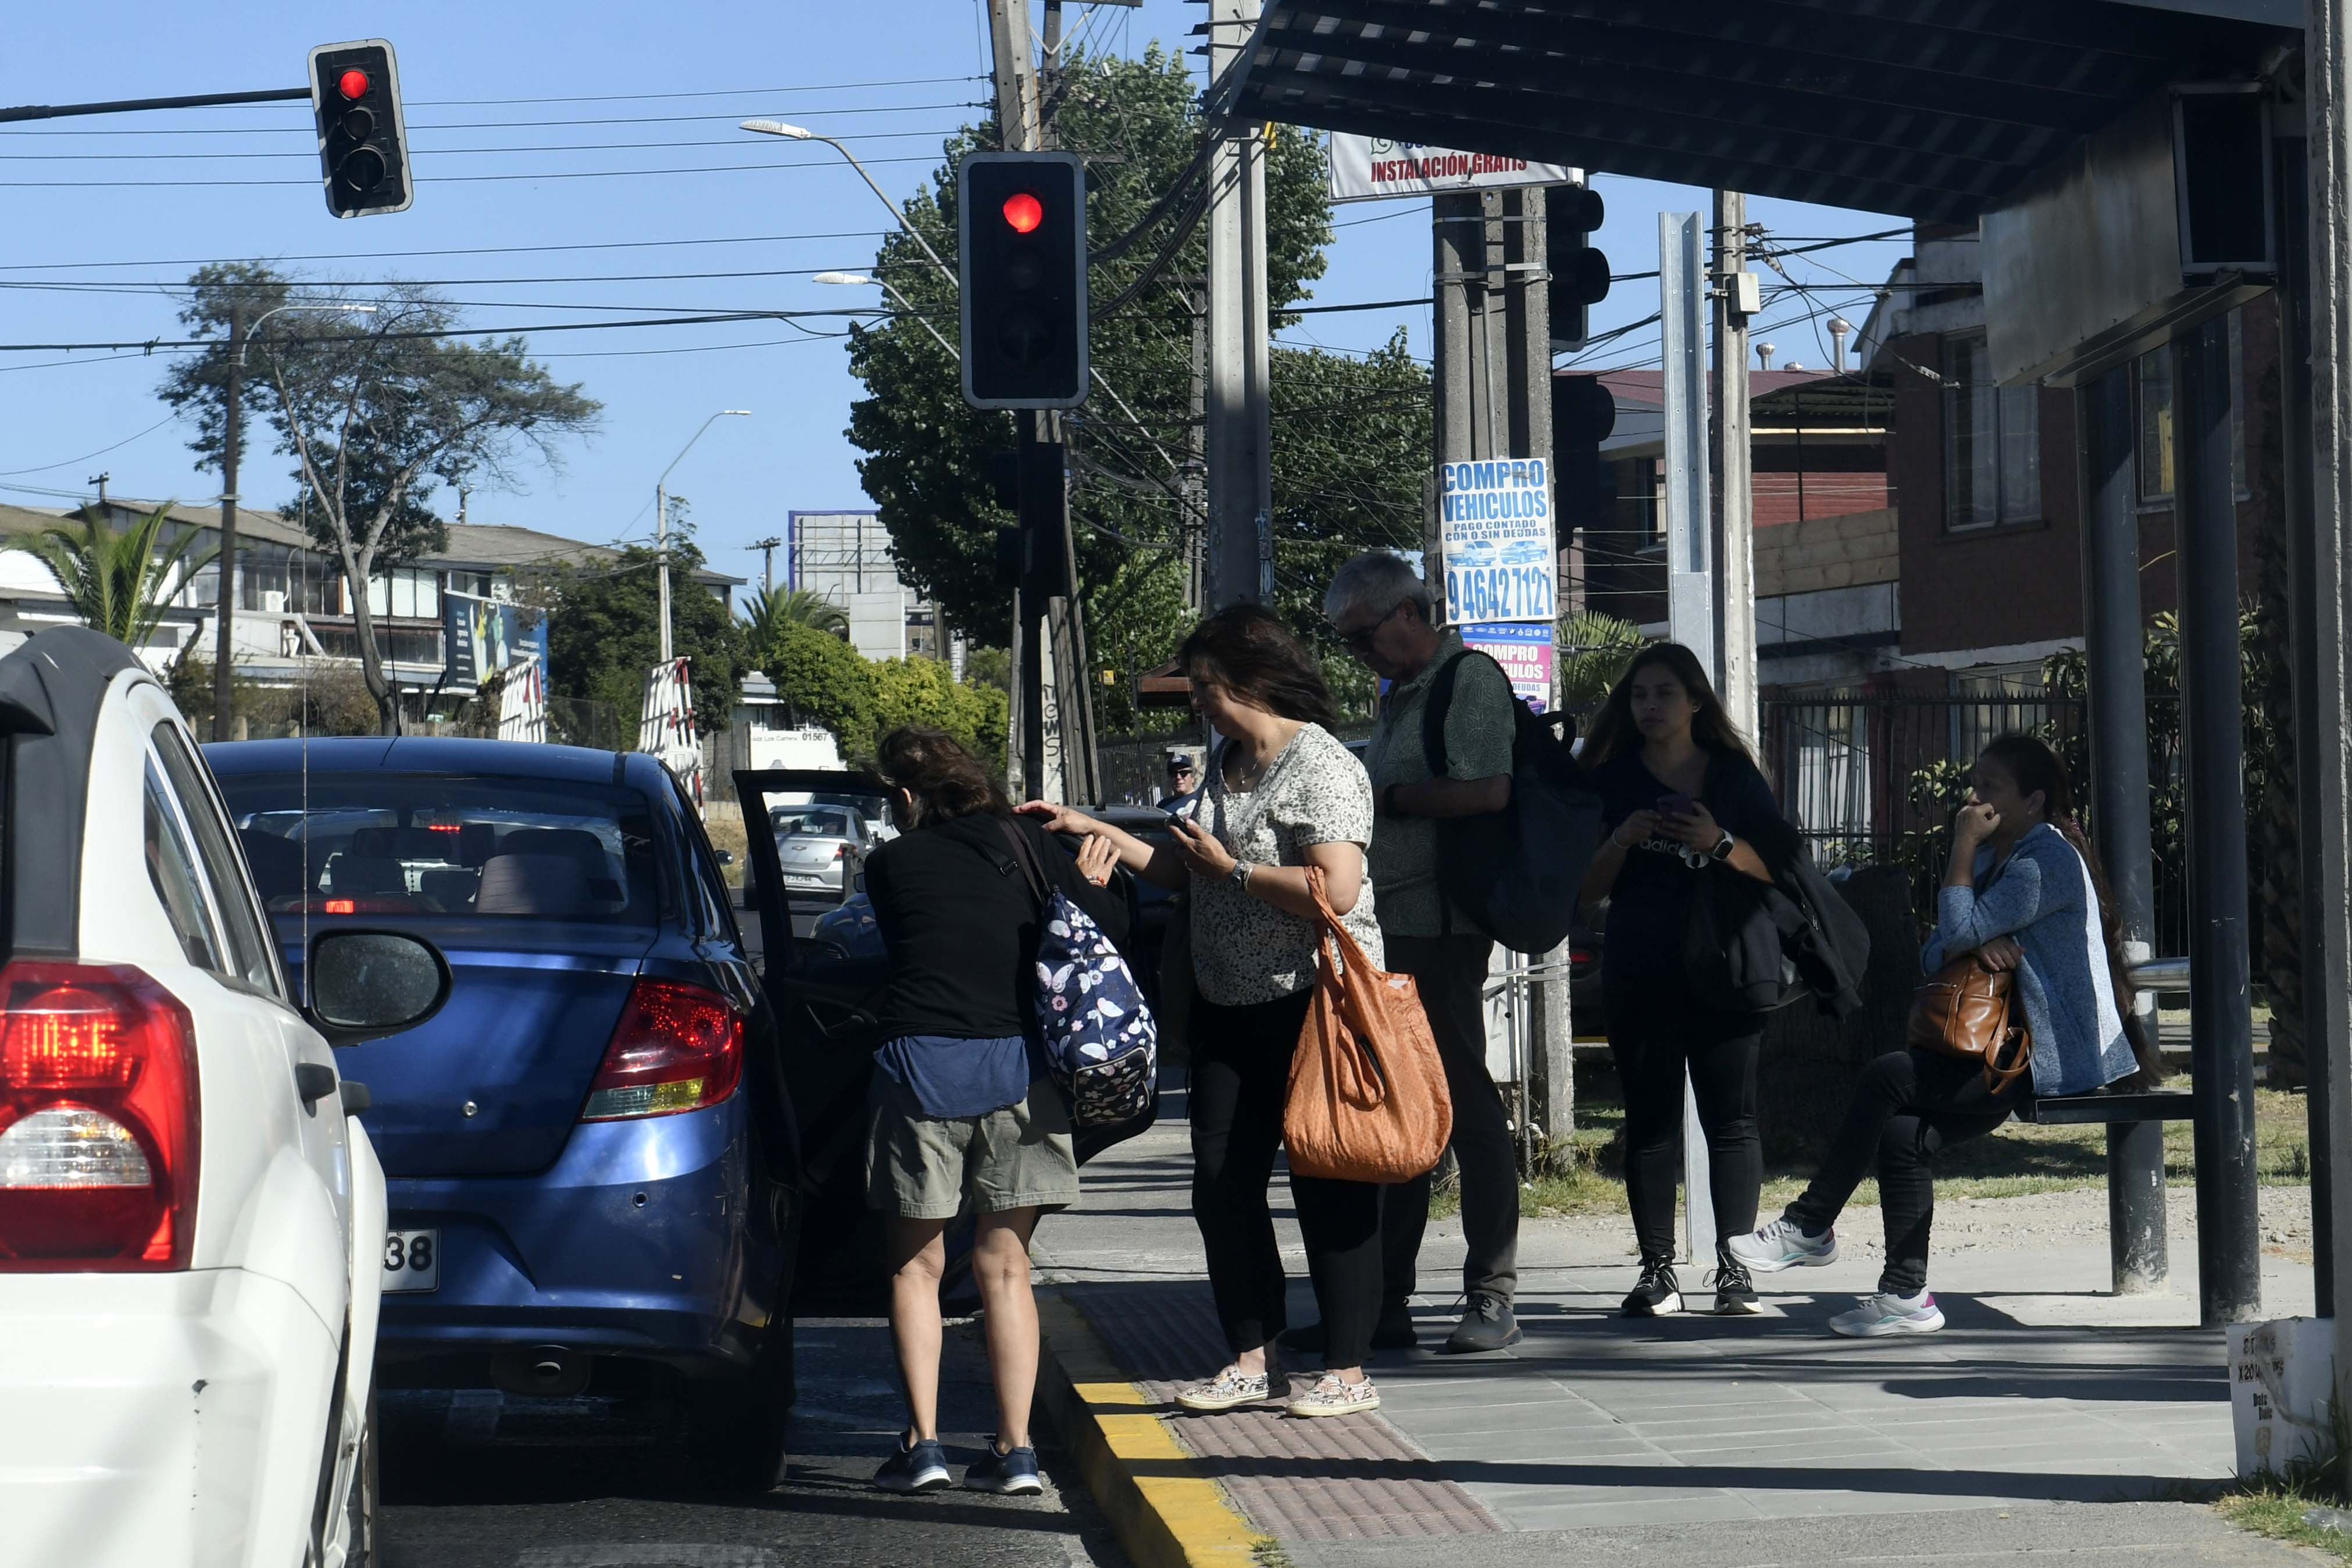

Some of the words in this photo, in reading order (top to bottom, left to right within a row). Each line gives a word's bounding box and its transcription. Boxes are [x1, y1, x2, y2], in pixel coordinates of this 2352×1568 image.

[1371, 151, 1468, 182] INSTALACIÓN
[1441, 460, 1544, 492] COMPRO
[1443, 490, 1547, 522] VEHICULOS
[1454, 522, 1483, 531] PAGO
[1486, 519, 1536, 530] CONTADO
[1445, 532, 1468, 541] CON
[1471, 531, 1478, 540] O
[1481, 530, 1500, 540] SIN
[1503, 528, 1546, 538] DEUDAS
[1500, 663, 1543, 679] CULOS
[802, 733, 829, 741] 01567
[1640, 838, 1679, 855] adid
[384, 1235, 432, 1271] 38
